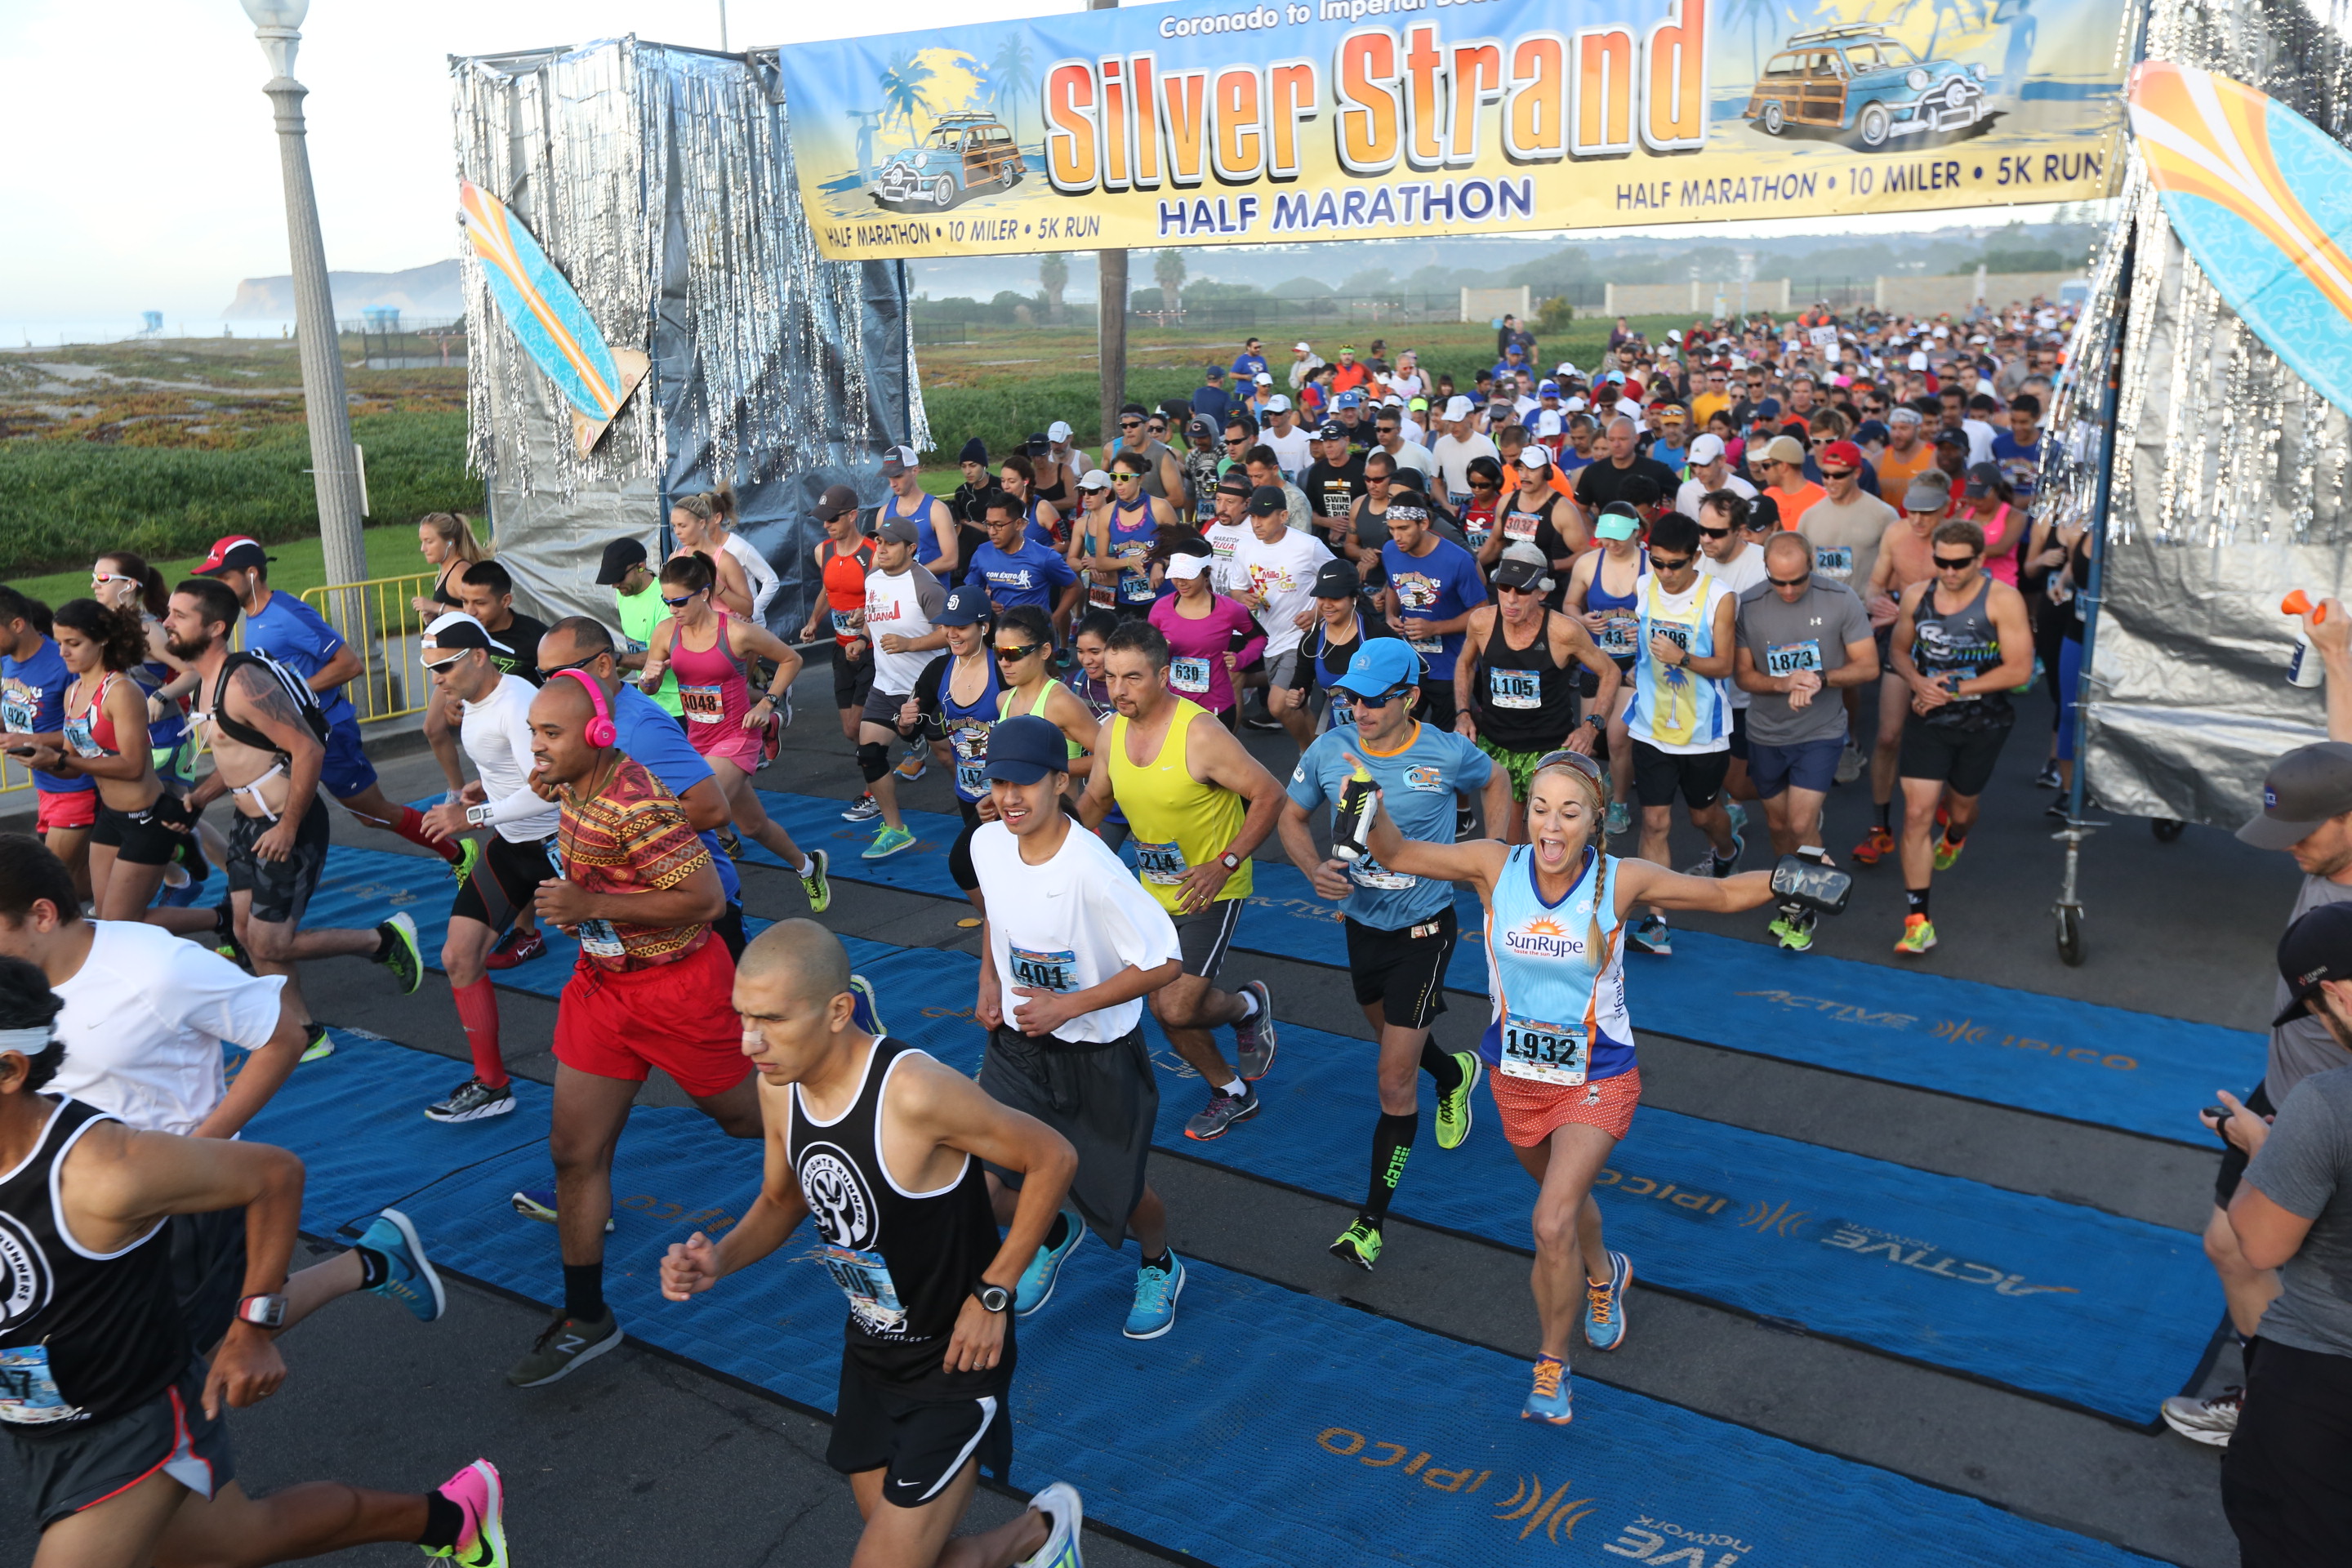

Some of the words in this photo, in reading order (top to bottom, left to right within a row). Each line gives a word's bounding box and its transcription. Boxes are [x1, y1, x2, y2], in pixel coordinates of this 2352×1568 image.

[1158, 11, 1279, 38] Coronado
[1285, 3, 1312, 26] to
[1045, 54, 1318, 189] Silver
[1336, 0, 1708, 172] Strand
[1617, 181, 1672, 210] HALF
[1681, 172, 1818, 207] MARATHON
[1849, 167, 1873, 195] 10
[1883, 161, 1961, 193] MILER
[1997, 156, 2032, 185] 5K
[2044, 152, 2102, 182] RUN
[1158, 196, 1258, 238] HALF
[1272, 175, 1534, 232] MARATHON
[826, 226, 852, 248] HALF
[857, 221, 931, 247] MARATHON
[948, 220, 964, 243] 10
[970, 218, 1018, 243] MILER
[1038, 216, 1059, 238] 5K
[1065, 214, 1101, 238] RUN
[1325, 495, 1350, 504] SWIM
[1331, 503, 1350, 511] BIKE
[1506, 518, 1534, 532] 3037
[1213, 541, 1236, 550] TIJUA
[1819, 554, 1842, 567] 208
[1124, 579, 1149, 594] 1735
[1262, 571, 1280, 579] Milla
[1280, 581, 1297, 589] Oro
[1090, 589, 1111, 604] 3087
[1771, 650, 1814, 671] 1873
[1492, 677, 1534, 697] 1105
[681, 693, 717, 711] 3048
[1140, 852, 1178, 873] 214
[1505, 931, 1584, 958] SunRype
[1019, 961, 1067, 989] 401
[1733, 989, 1920, 1027] ACTIVE
[2000, 1035, 2139, 1071] IPICO
[1506, 1028, 1577, 1066] 1932
[1383, 1161, 1405, 1188] cep
[804, 1157, 834, 1189] HEIGHTS
[836, 1168, 866, 1227] RUNNERS
[1820, 1229, 2080, 1297] ACTIVE
[1316, 1426, 1493, 1494] IPICO
[1633, 1513, 1753, 1553] network
